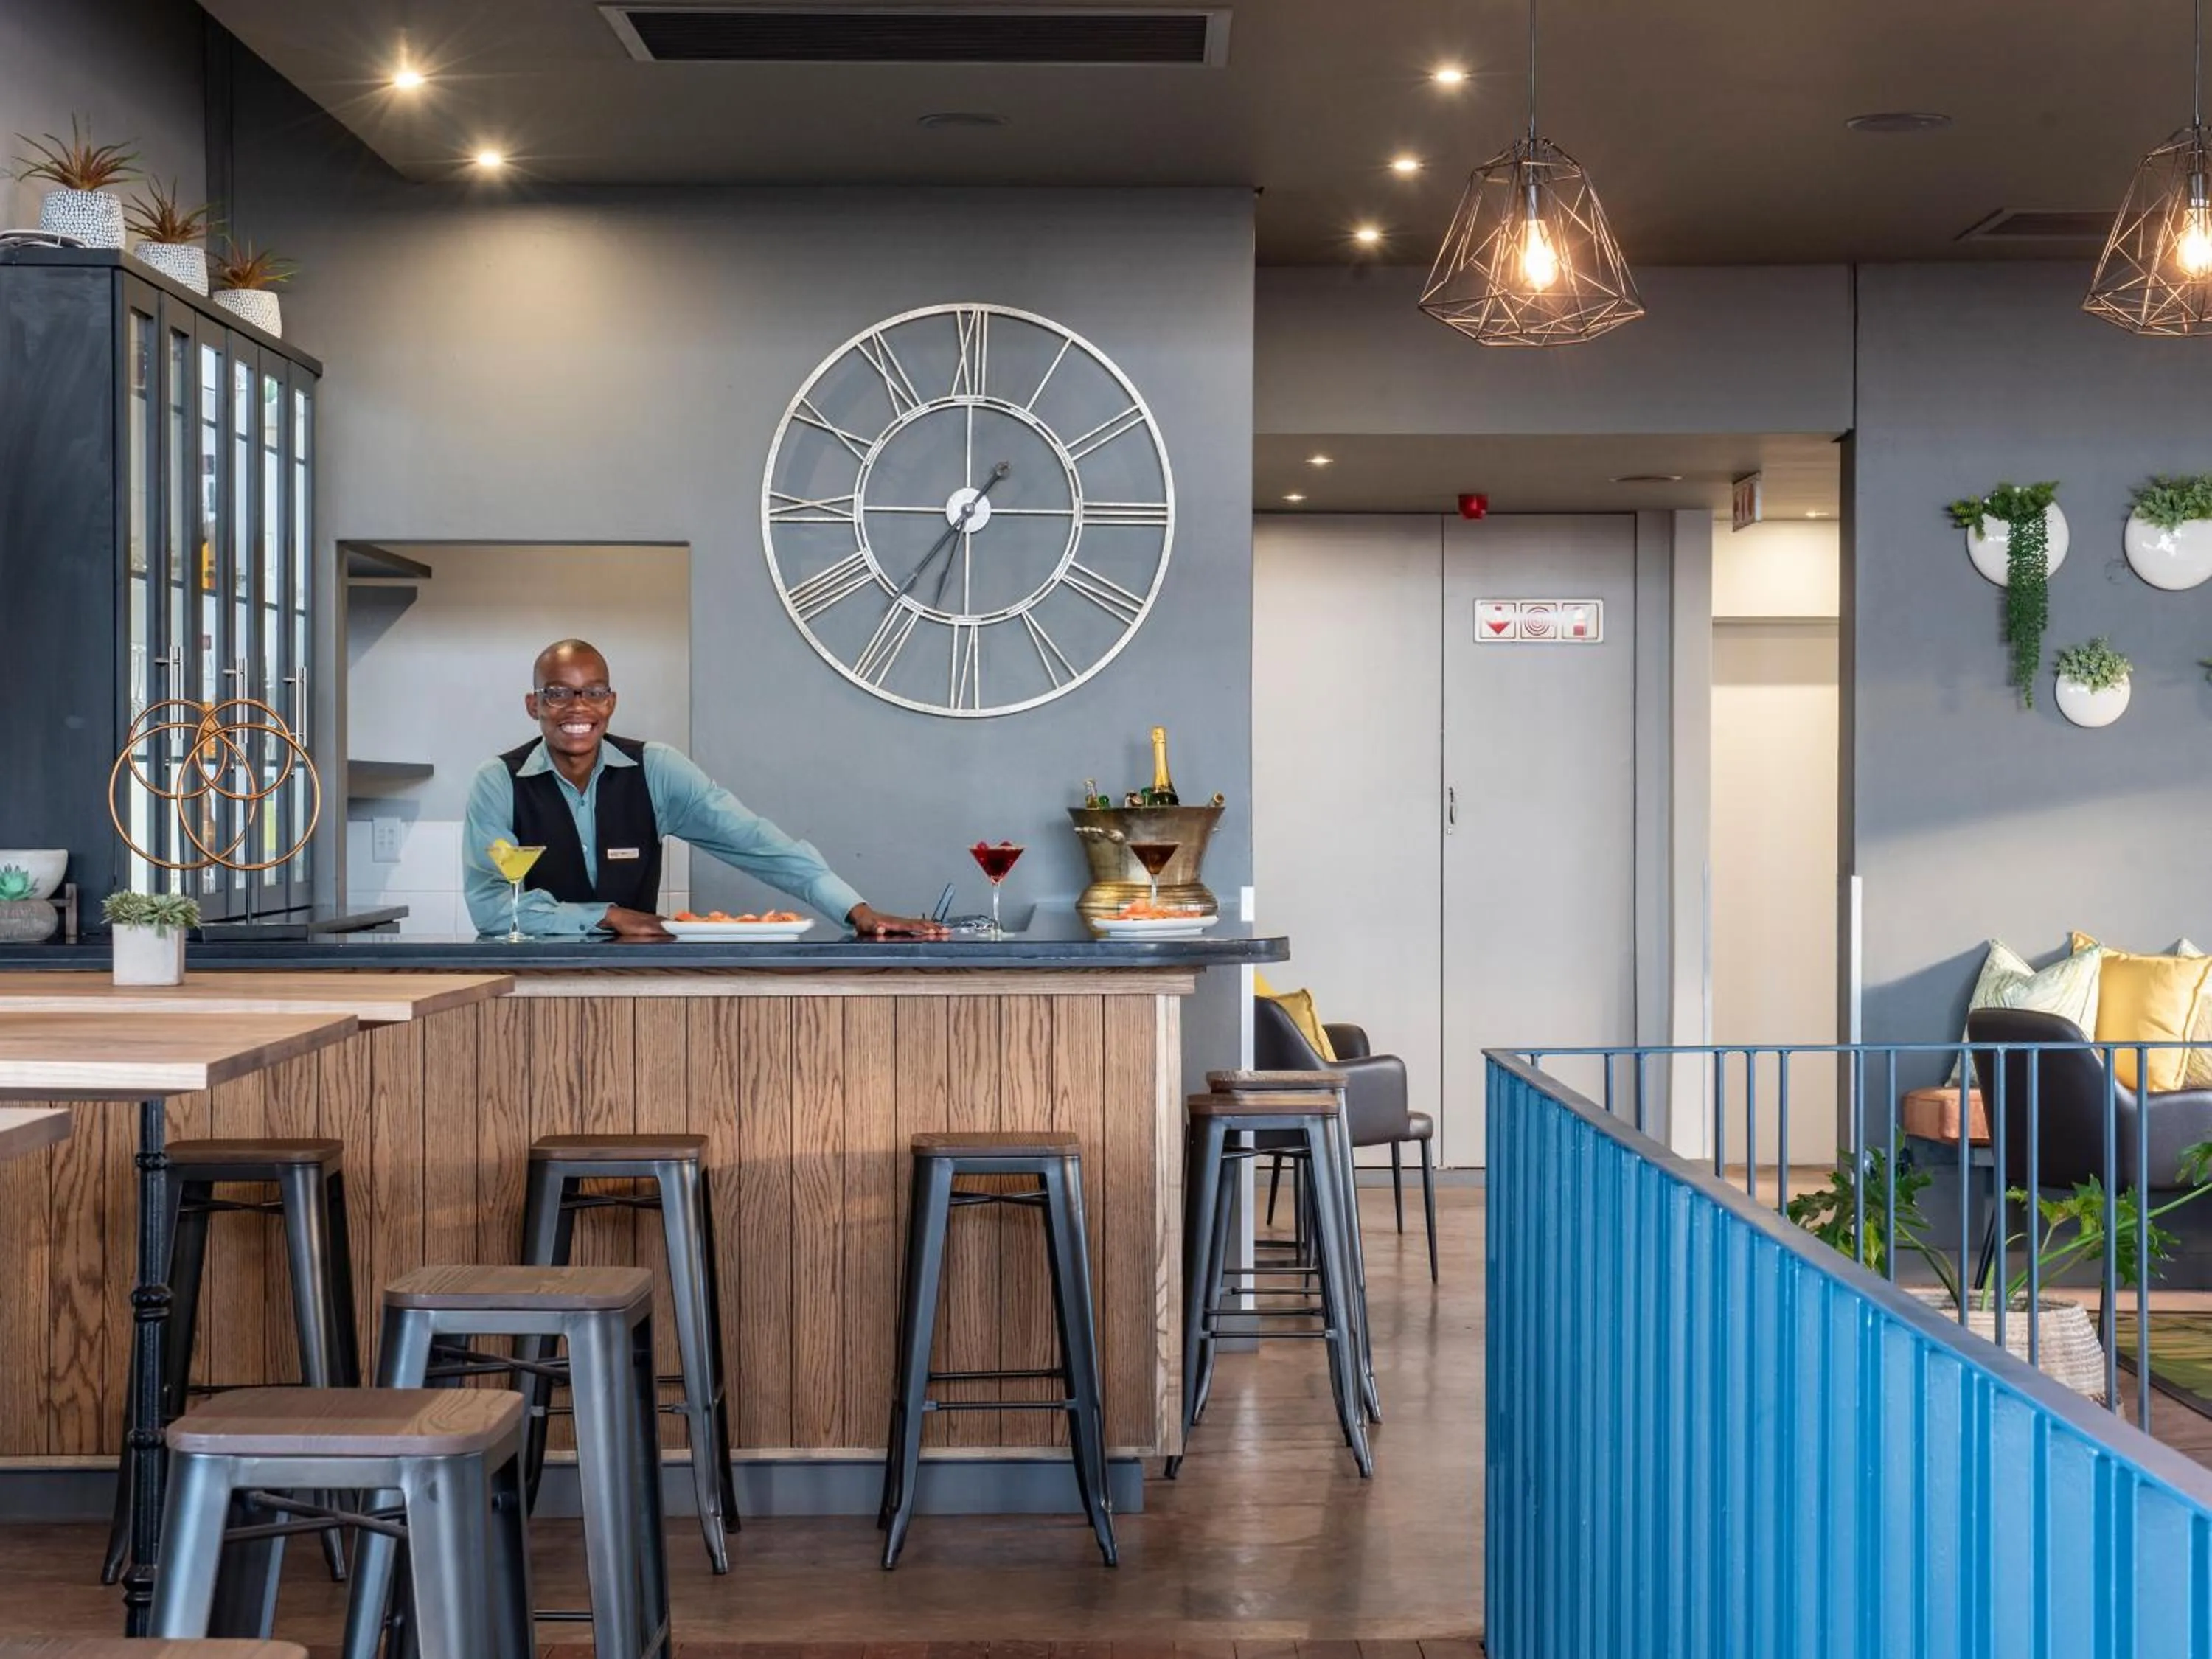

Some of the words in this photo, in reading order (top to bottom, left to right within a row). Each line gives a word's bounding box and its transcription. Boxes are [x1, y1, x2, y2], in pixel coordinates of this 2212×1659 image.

[856, 331, 922, 417] XI
[951, 310, 987, 397] XII
[793, 397, 873, 462] X
[1065, 405, 1145, 461] II
[769, 490, 855, 521] IX
[1082, 502, 1167, 524] III
[787, 550, 874, 622] VIII
[1062, 560, 1145, 625] IV
[852, 599, 919, 686] VII
[950, 625, 979, 709] VI
[1020, 610, 1079, 689] V
